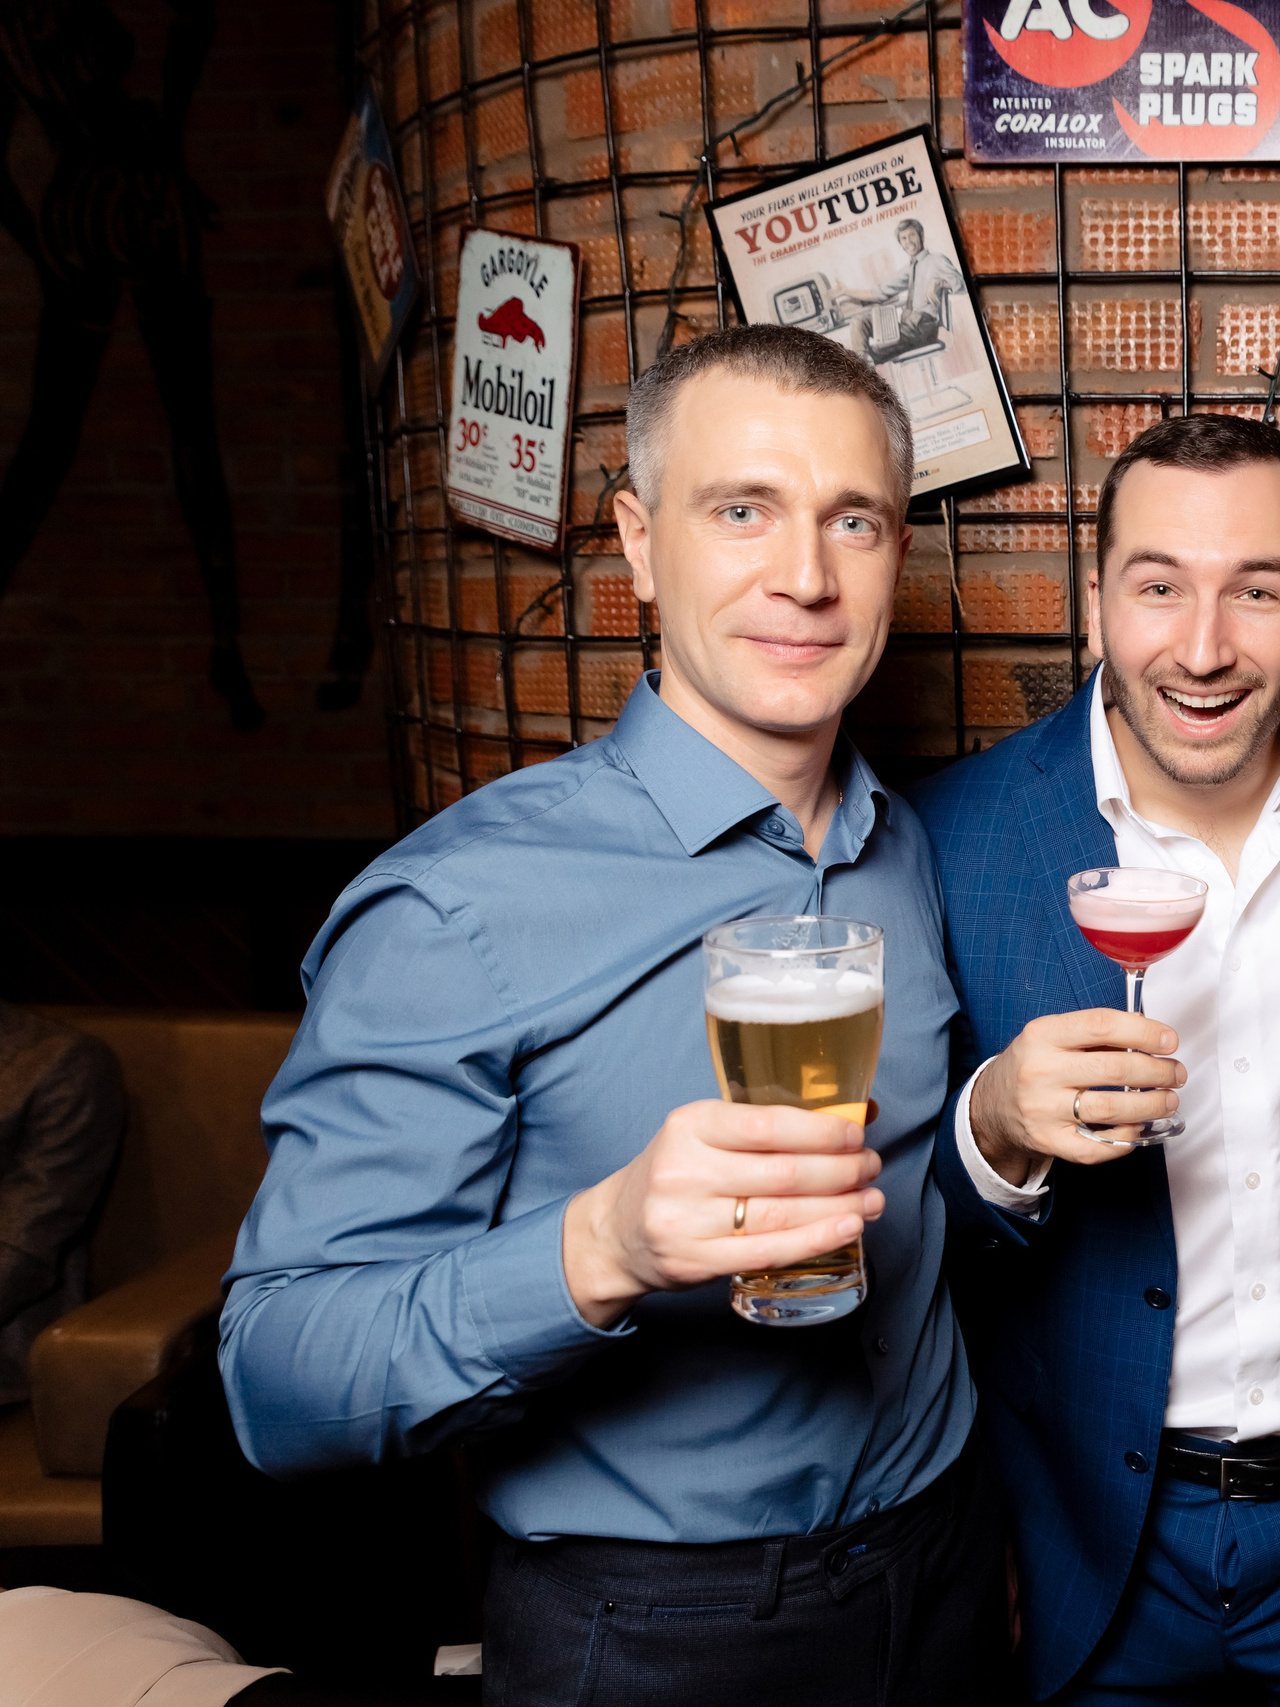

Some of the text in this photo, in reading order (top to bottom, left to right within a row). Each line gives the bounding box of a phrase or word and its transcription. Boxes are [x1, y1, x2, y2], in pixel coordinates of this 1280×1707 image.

[1139, 52, 1259, 86] SPARK
[993, 97, 1052, 110] PATENTED
[995, 113, 1104, 133] CORALOX
[1139, 92, 1258, 126] PLUGS
[1045, 136, 1107, 149] INSULATOR
[734, 166, 923, 254] YOUTUBE
[740, 154, 905, 223] YOUR FILMS WILL LAST FOREVER ON
[752, 199, 918, 267] THE CHAMPION ADDRESS ON INTERNET!
[481, 247, 549, 299] GARGOYLE
[462, 355, 555, 430] Mobiloil
